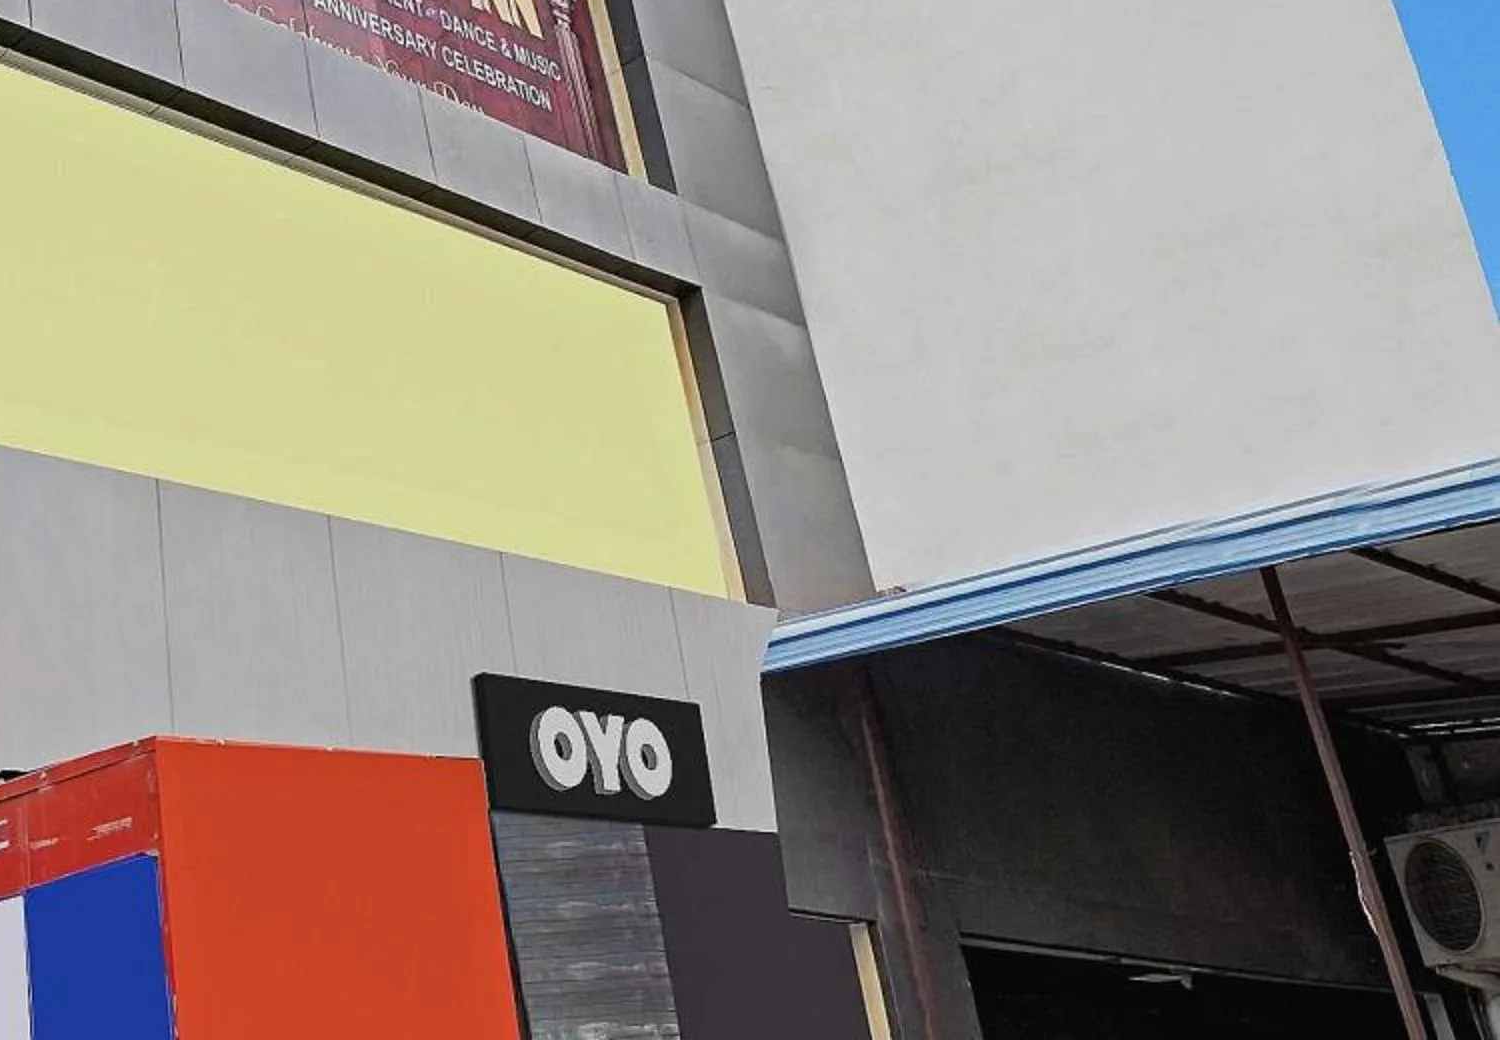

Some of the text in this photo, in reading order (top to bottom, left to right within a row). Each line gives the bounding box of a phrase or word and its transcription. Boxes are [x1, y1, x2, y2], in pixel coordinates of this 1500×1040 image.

[439, 10, 497, 53] DANCE
[514, 45, 562, 82] MUSIC
[441, 47, 552, 112] CELEBRATION
[530, 706, 673, 800] OYO
